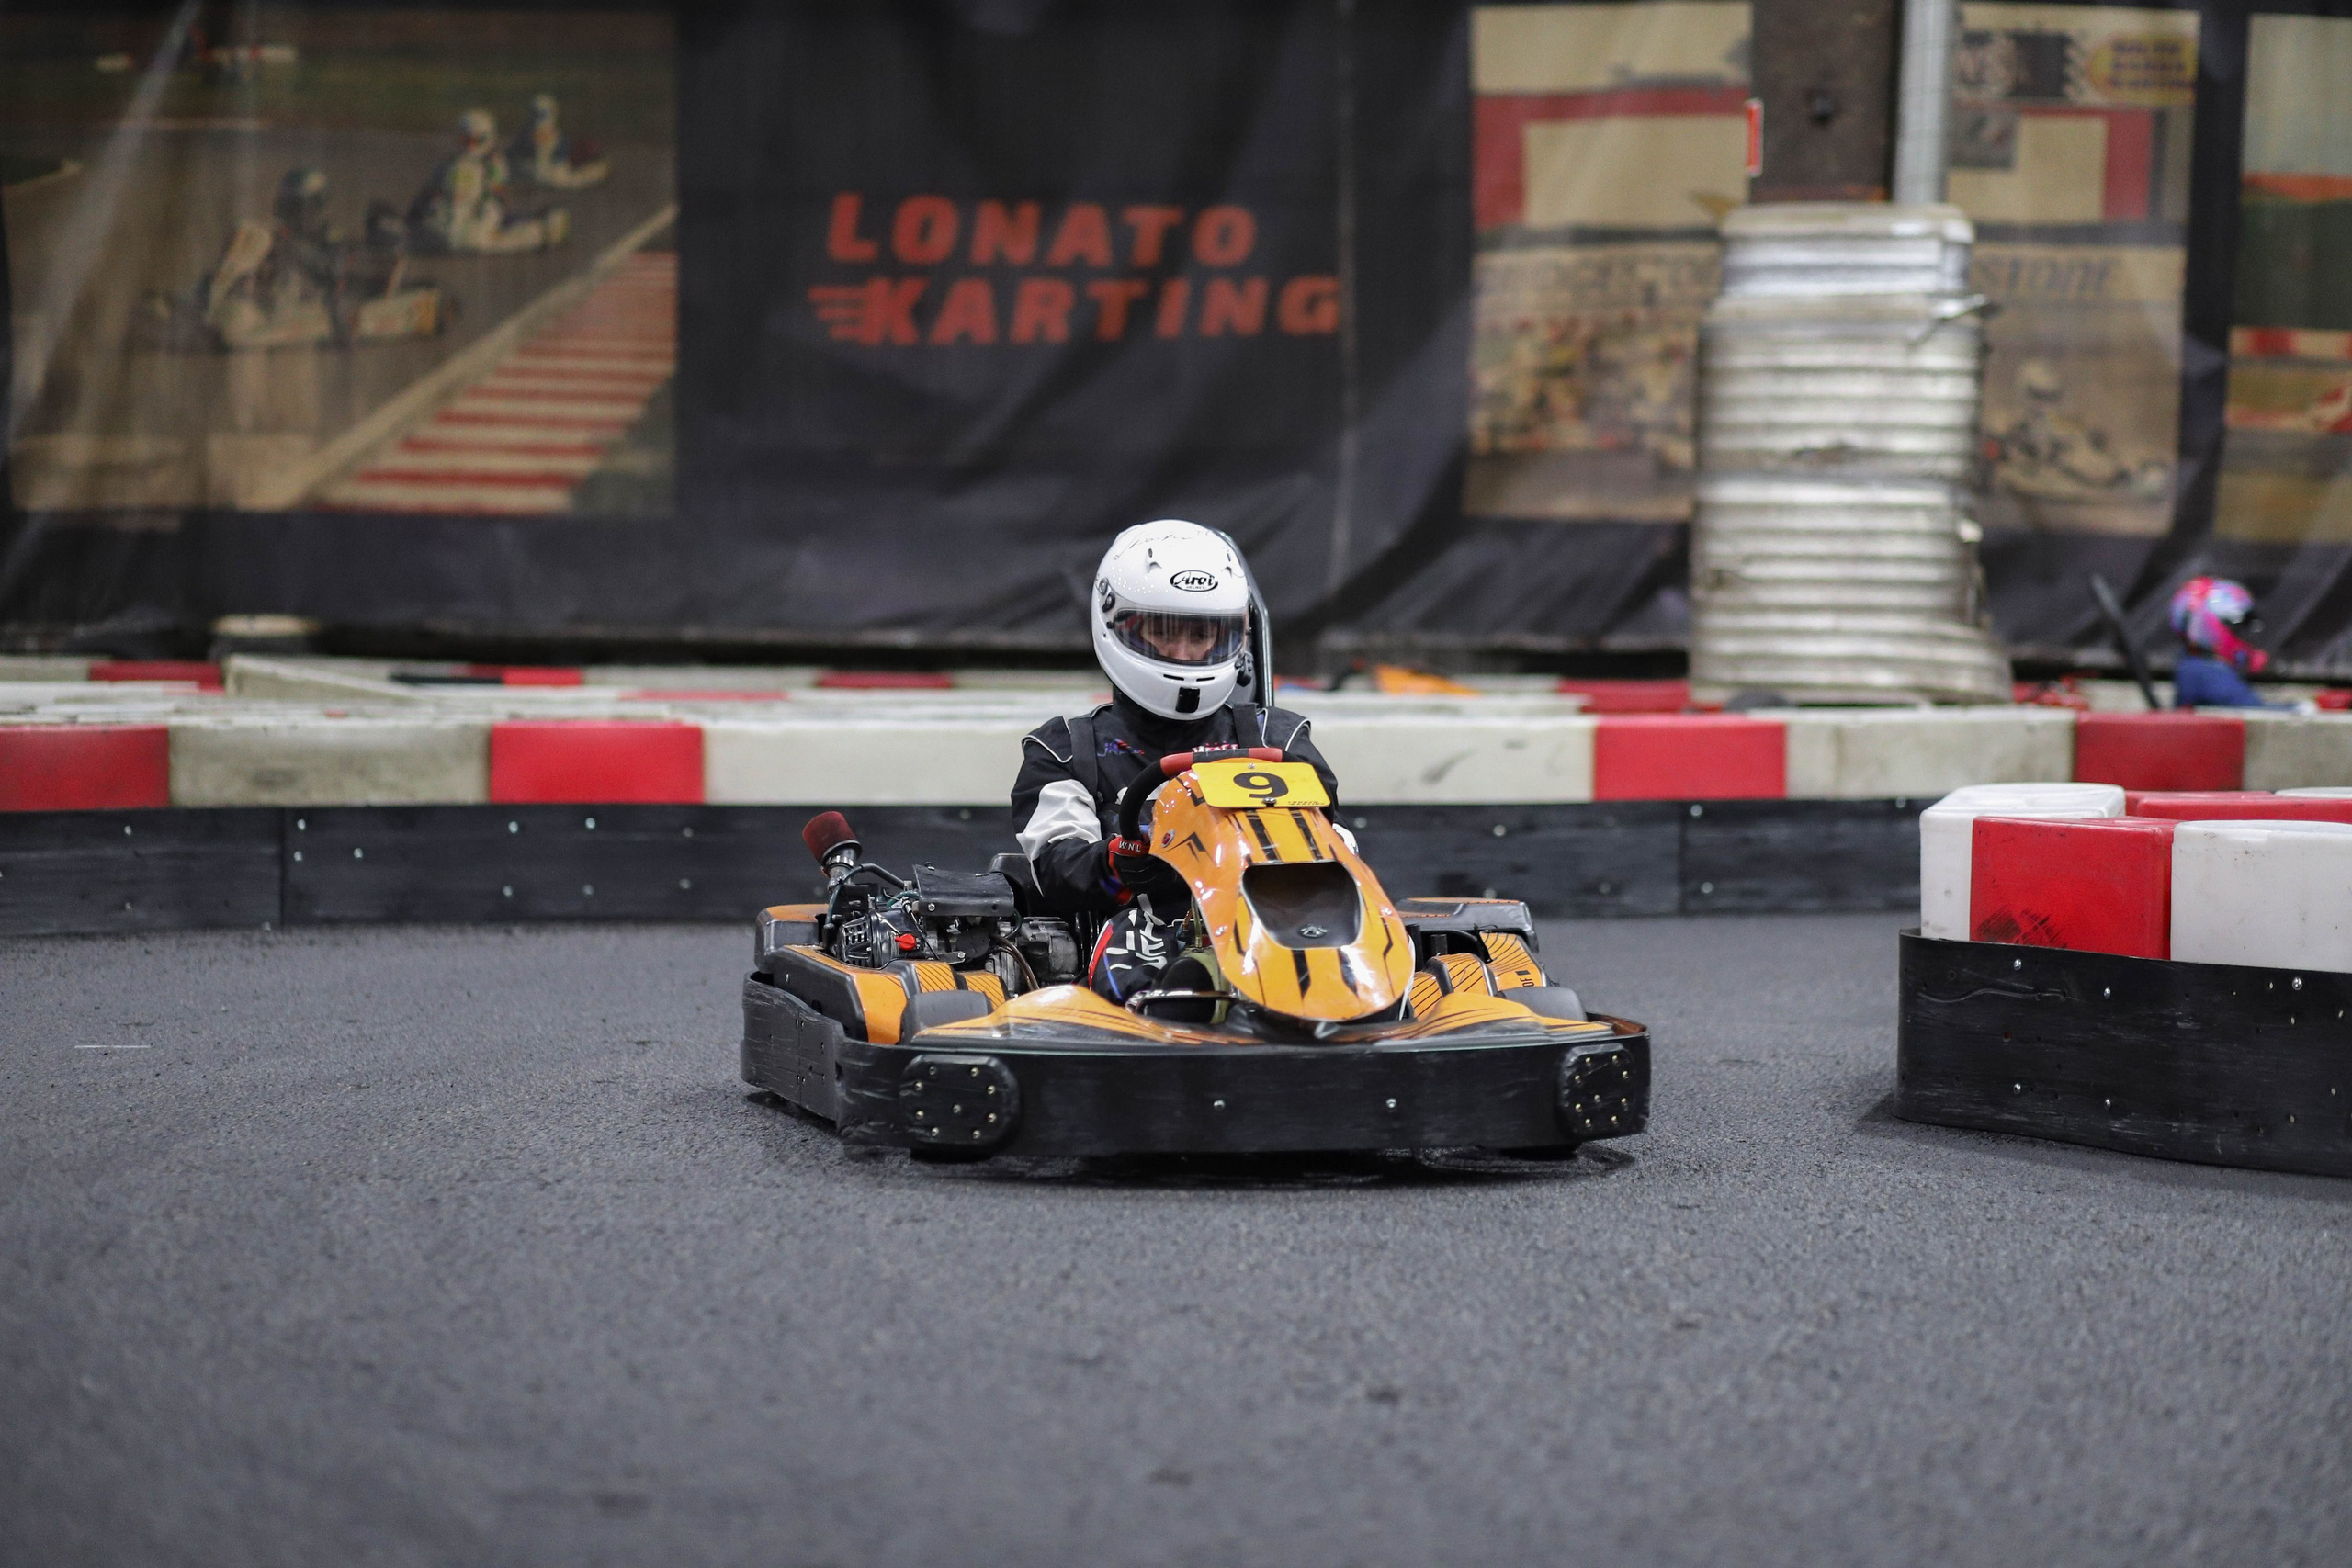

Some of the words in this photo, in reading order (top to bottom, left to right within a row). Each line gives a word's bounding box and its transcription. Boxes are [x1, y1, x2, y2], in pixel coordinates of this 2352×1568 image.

[829, 192, 1258, 266] LONATO
[810, 276, 1340, 345] KARTING
[1233, 772, 1289, 798] 9
[1118, 840, 1142, 852] WNL
